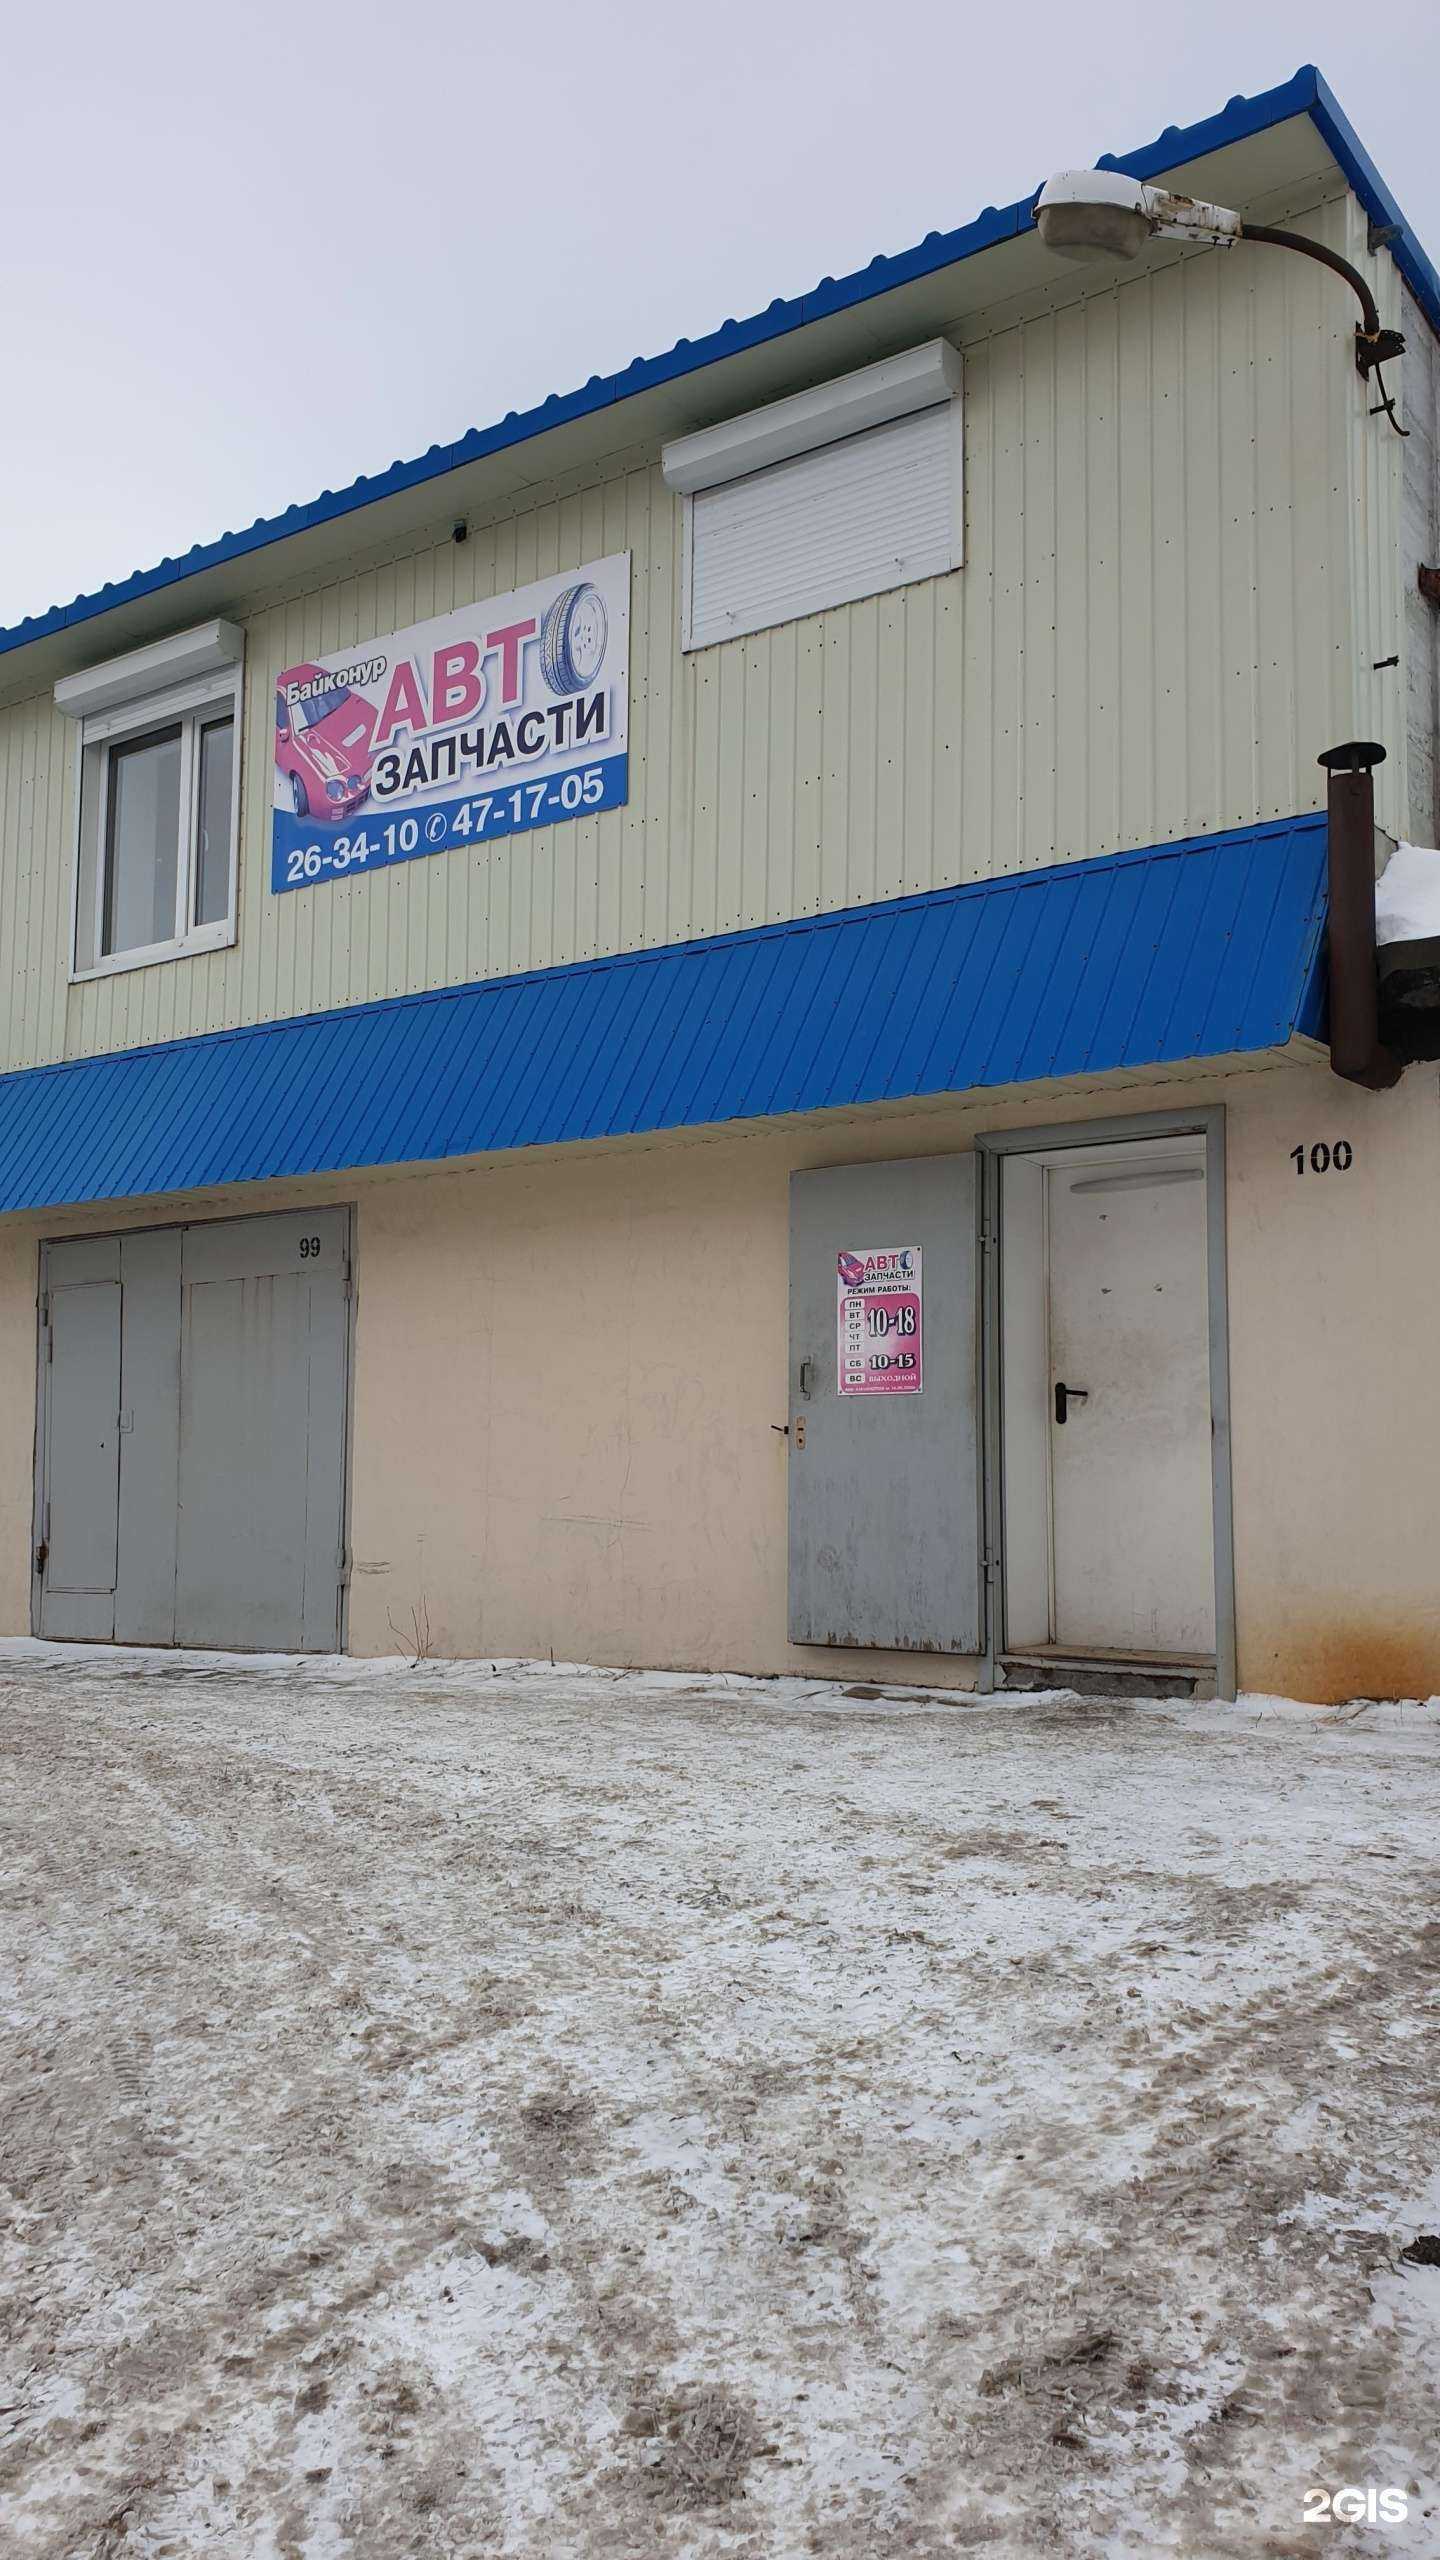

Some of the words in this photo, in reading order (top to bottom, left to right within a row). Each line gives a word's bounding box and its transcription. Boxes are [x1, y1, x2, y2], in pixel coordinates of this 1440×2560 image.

[286, 656, 387, 705] Байконур
[375, 692, 606, 796] ЗАПЧАСТИ
[287, 819, 420, 882] 26-34-10
[452, 768, 604, 836] 47-17-05
[1290, 1140, 1353, 1175] 100
[299, 1236, 321, 1259] 99
[864, 1270, 914, 1281] ЗАПЧАСТИ
[847, 1286, 876, 1295] РЕЖИМ
[877, 1285, 912, 1293] РАБОТЫ:
[849, 1311, 860, 1319] ВТ
[867, 1306, 916, 1338] 10-18
[849, 1322, 861, 1330] СР
[849, 1333, 860, 1341] ЧТ
[849, 1344, 860, 1352] ПТ
[849, 1359, 861, 1368] СБ
[869, 1353, 916, 1370] 10-15
